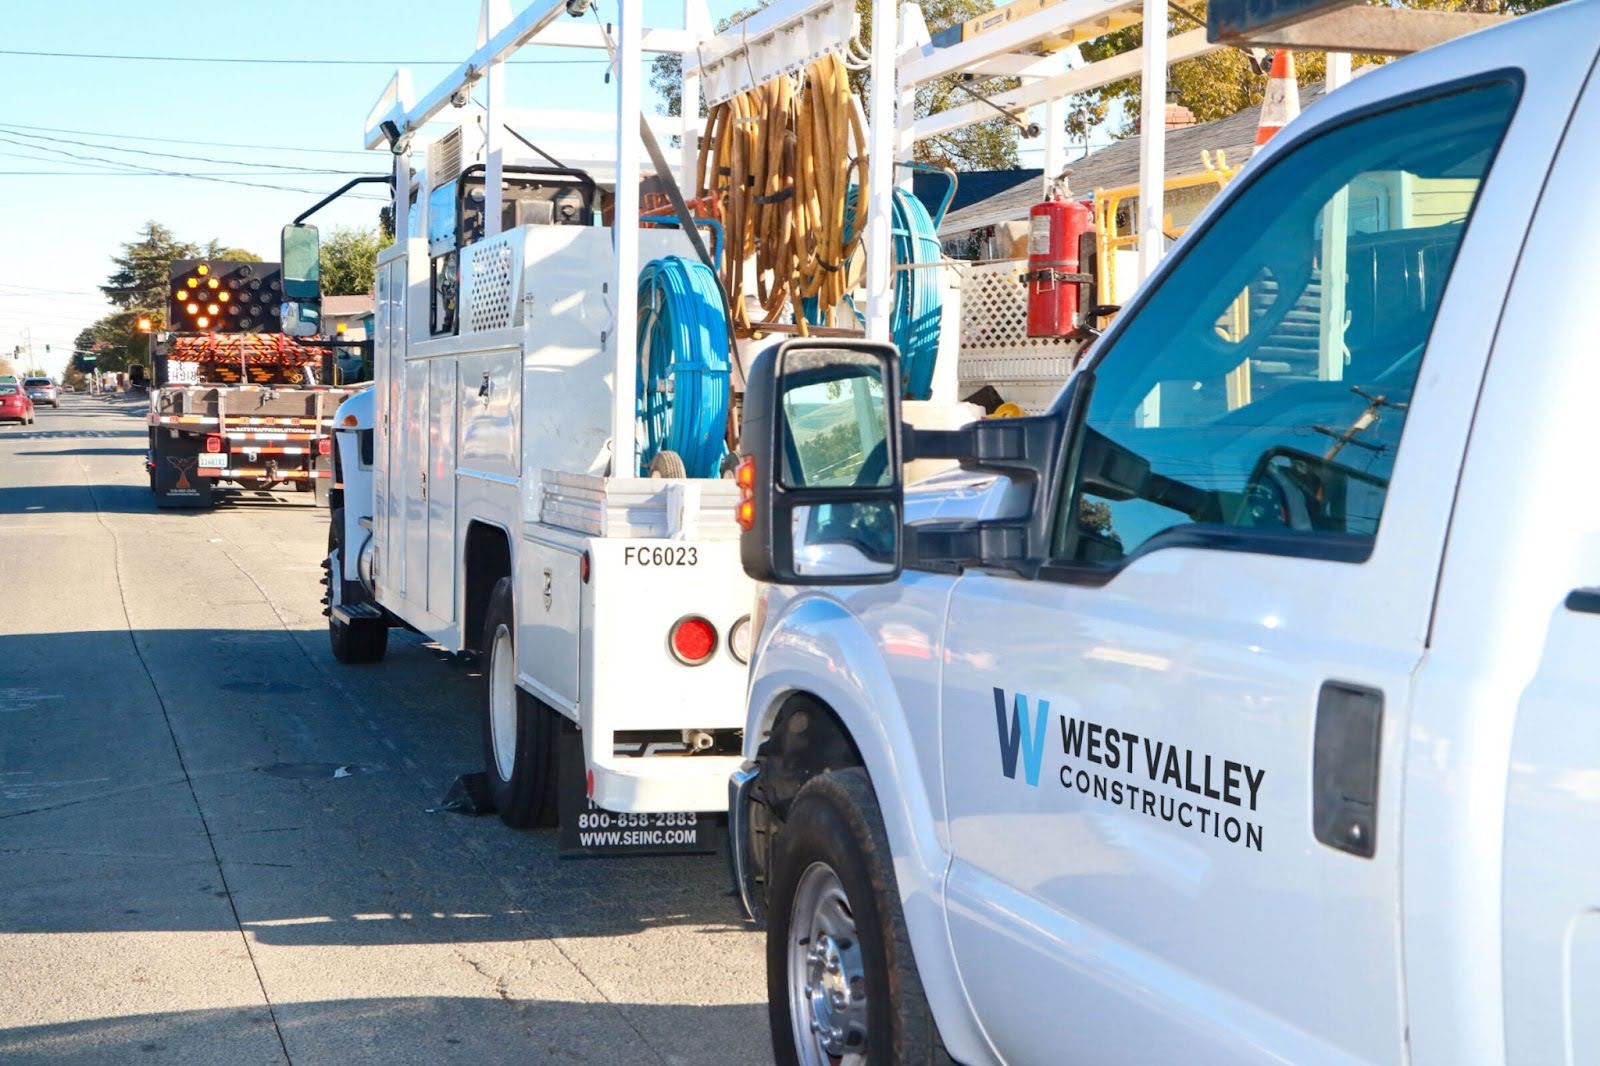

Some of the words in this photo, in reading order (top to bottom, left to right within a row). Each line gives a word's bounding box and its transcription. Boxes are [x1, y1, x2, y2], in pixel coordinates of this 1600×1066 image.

[624, 546, 698, 566] FC6023
[1060, 715, 1139, 774] WEST
[1144, 738, 1265, 811] VALLEY
[1060, 765, 1263, 852] CONSTRUCTION
[578, 812, 697, 829] 800-858-2883
[579, 829, 697, 847] WWW.SEINC.COM
